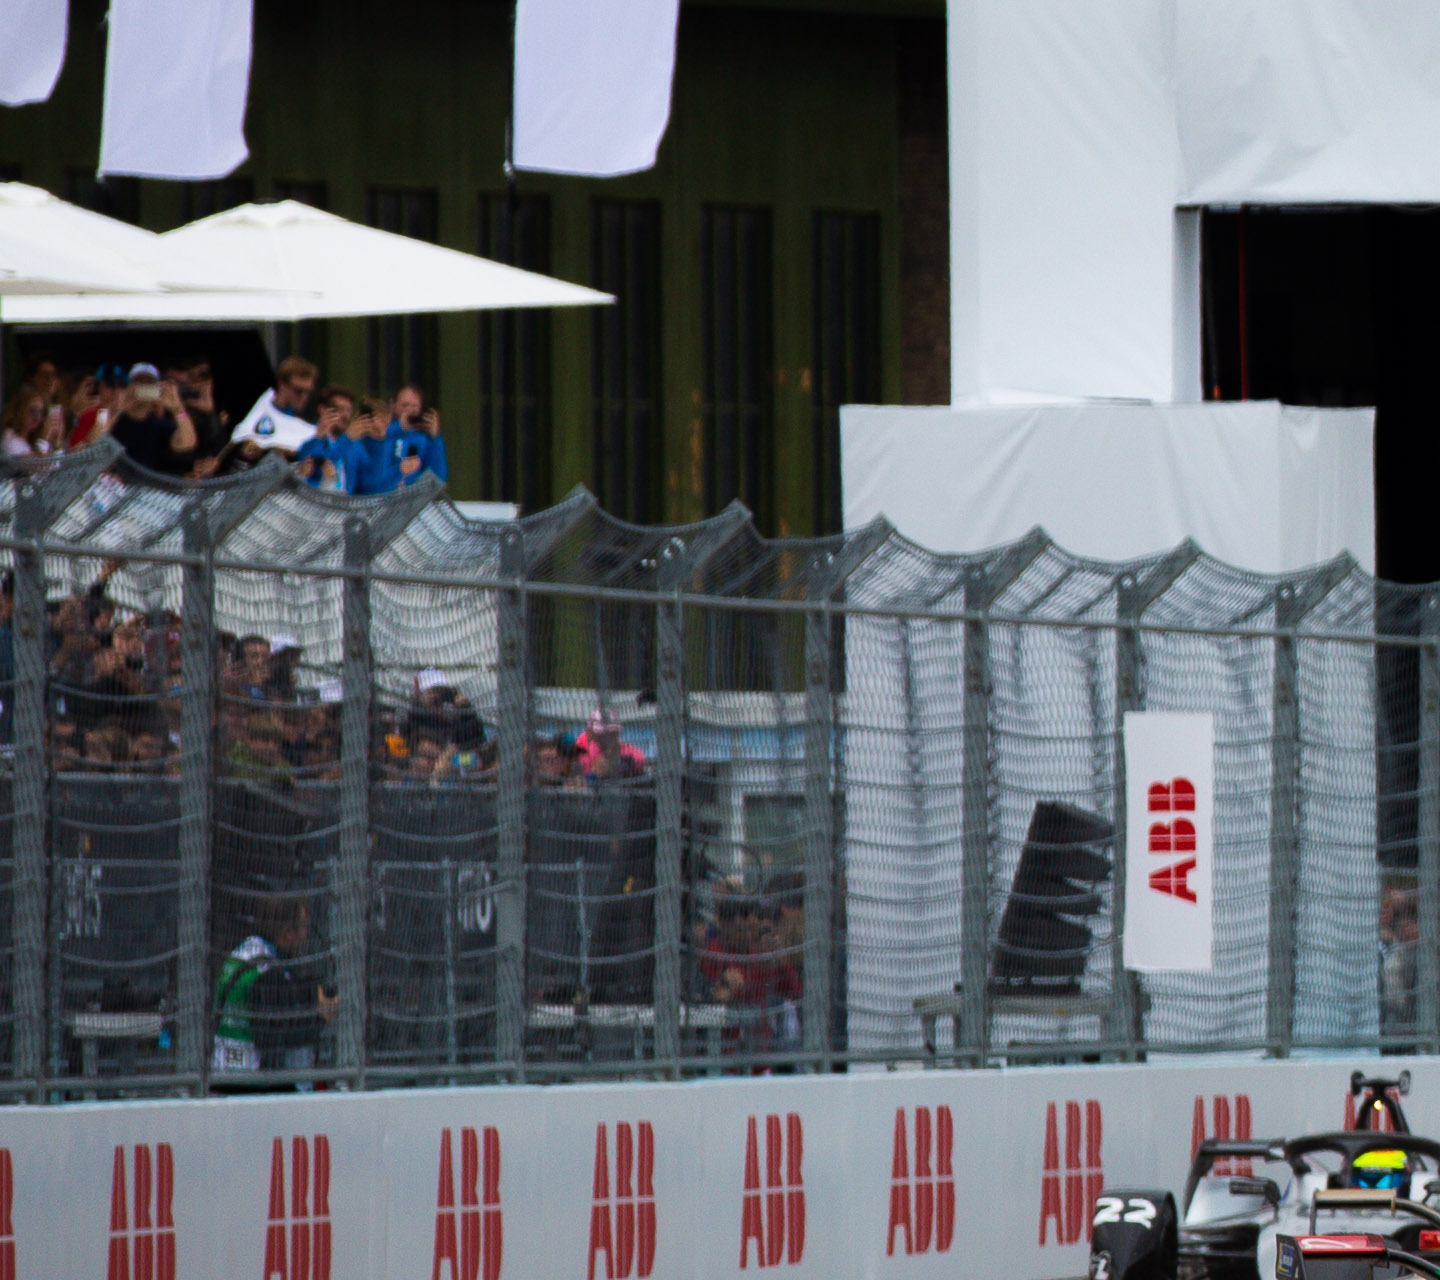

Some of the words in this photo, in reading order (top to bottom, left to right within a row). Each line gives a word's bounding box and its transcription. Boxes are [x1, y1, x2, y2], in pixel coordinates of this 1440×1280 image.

[1149, 777, 1198, 905] ABB
[741, 1115, 806, 1269] ABB
[888, 1107, 956, 1257] ABB
[1040, 1102, 1105, 1246] ABB
[1093, 1197, 1156, 1230] 22
